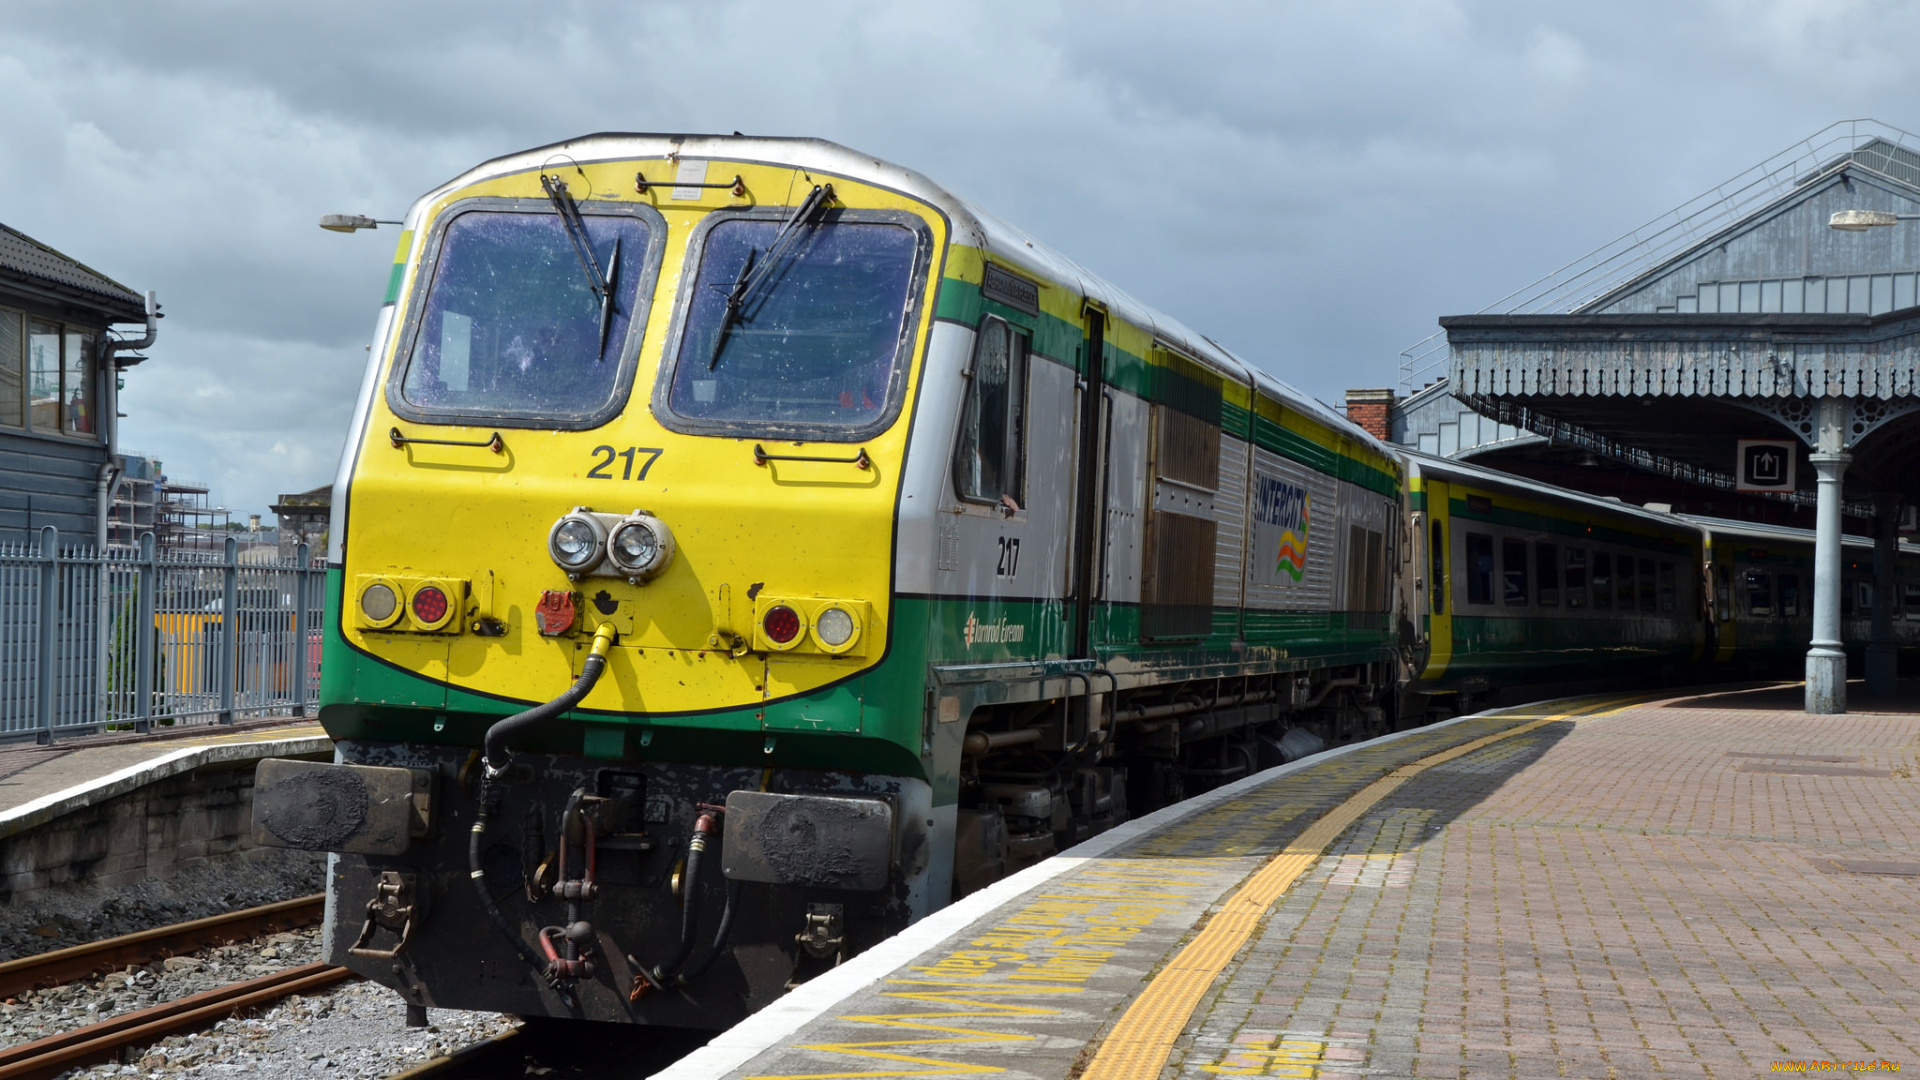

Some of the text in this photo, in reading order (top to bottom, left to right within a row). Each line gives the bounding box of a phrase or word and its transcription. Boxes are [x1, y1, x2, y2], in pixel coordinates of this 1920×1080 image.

[586, 445, 664, 481] 217
[1257, 476, 1307, 531] INTERCITY
[997, 536, 1020, 577] 217
[909, 950, 1029, 977] Gap
[1008, 904, 1181, 982] Mind The Gap
